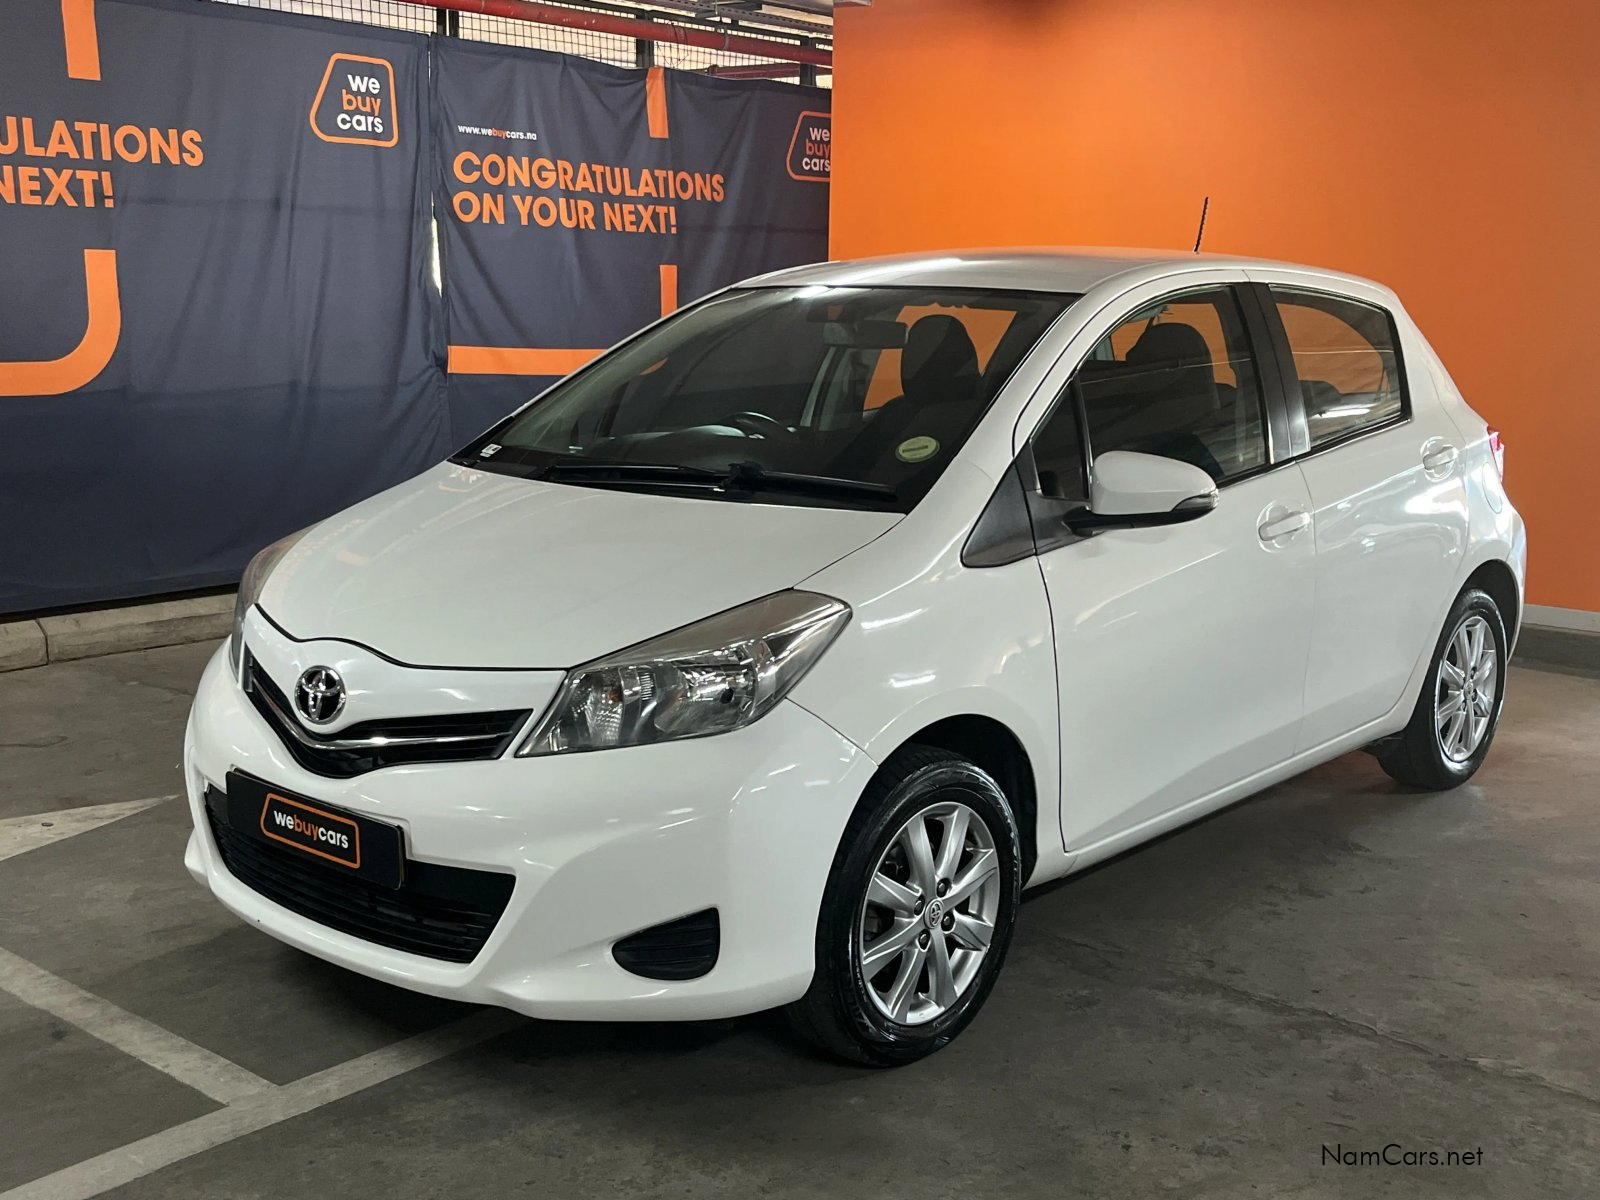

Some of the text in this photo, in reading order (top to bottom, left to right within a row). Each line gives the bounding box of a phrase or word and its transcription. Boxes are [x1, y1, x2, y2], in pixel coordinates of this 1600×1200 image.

[347, 74, 381, 94] we
[342, 89, 381, 116] buy
[336, 113, 383, 133] cars
[457, 125, 537, 140] www.webuycars.na
[809, 126, 831, 142] we
[805, 138, 831, 159] buy
[802, 157, 831, 172] cars
[452, 150, 725, 203] CONGRATULATIONS
[452, 190, 678, 235] ON YOUR NEXT!
[274, 810, 349, 849] webuycars
